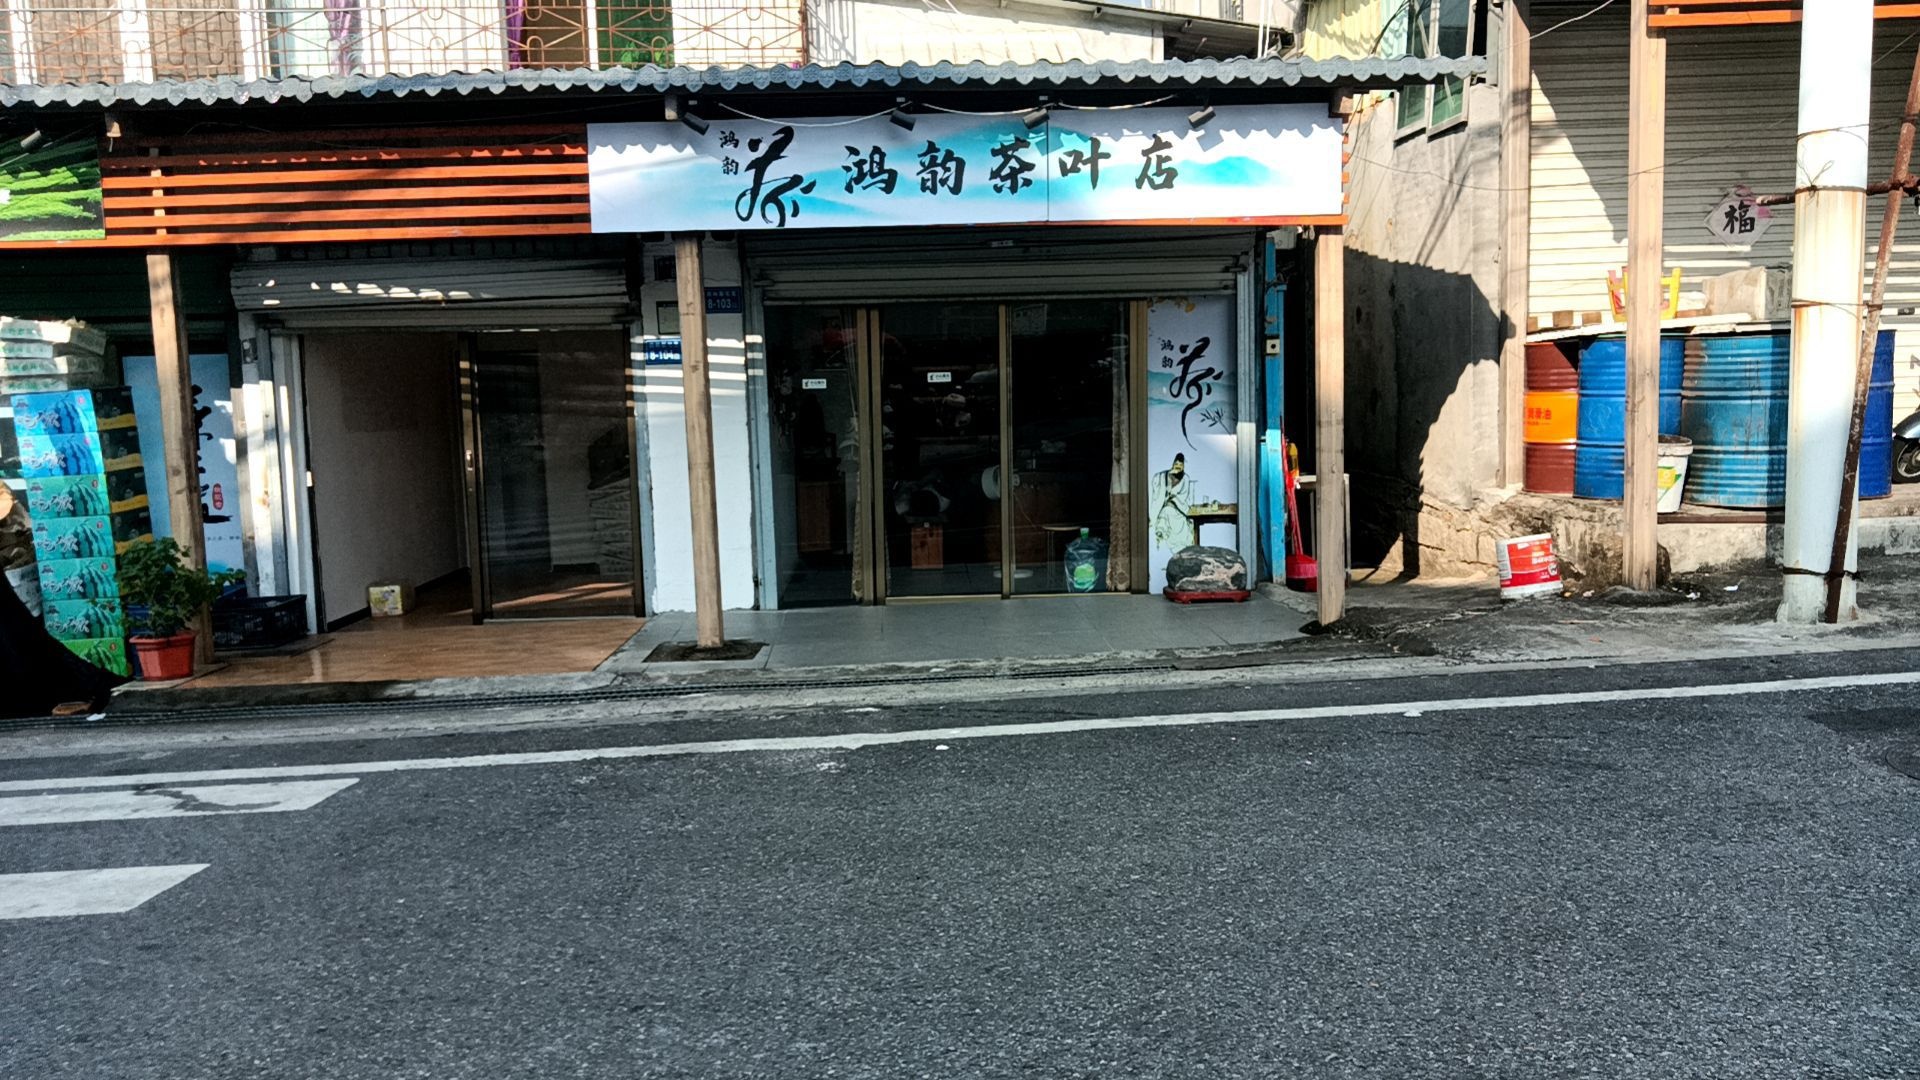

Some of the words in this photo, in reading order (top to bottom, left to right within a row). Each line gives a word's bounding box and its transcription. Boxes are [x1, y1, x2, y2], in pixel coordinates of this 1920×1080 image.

[719, 130, 739, 176] 鸿韵
[842, 134, 1178, 196] 鸿韵茶叶店
[1723, 200, 1755, 234] 福
